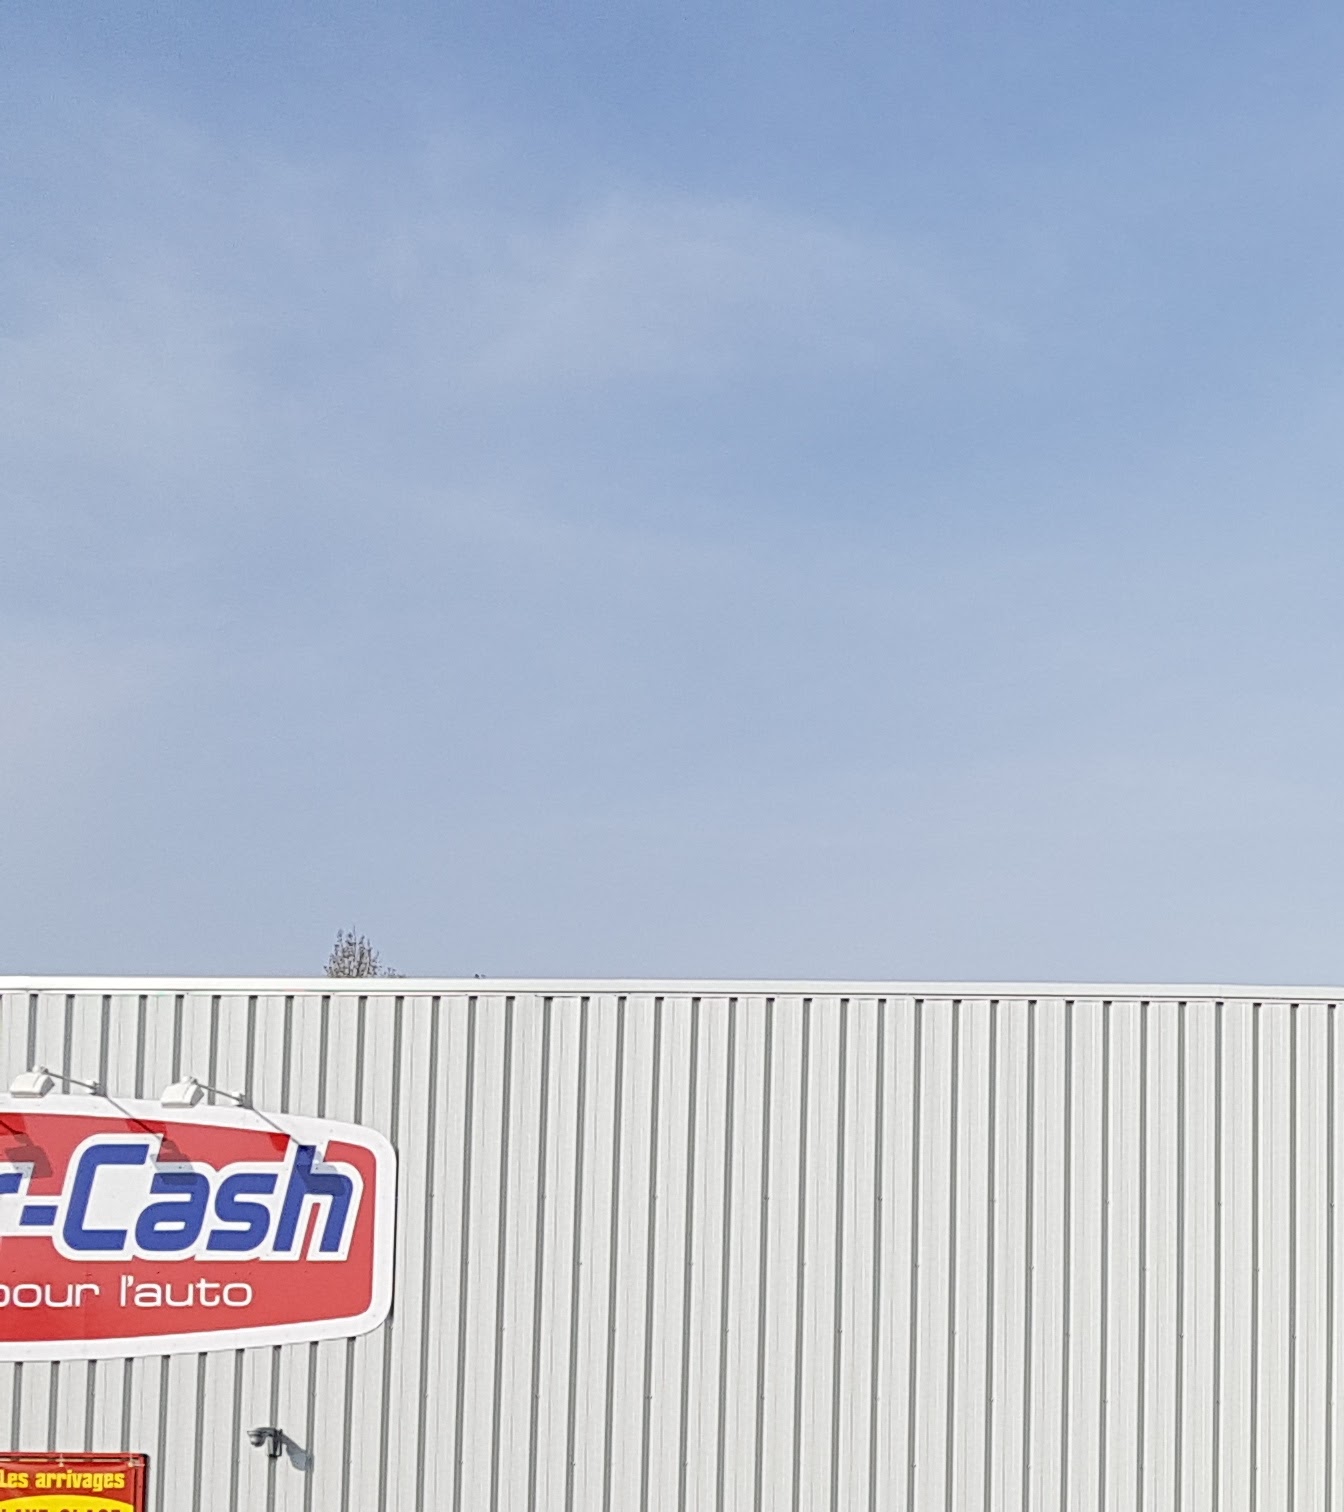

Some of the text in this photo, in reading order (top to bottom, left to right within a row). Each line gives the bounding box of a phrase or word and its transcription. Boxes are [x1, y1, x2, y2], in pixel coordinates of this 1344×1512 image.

[119, 1275, 253, 1307] l'auto
[0, 1470, 125, 1492] Les arrivages
